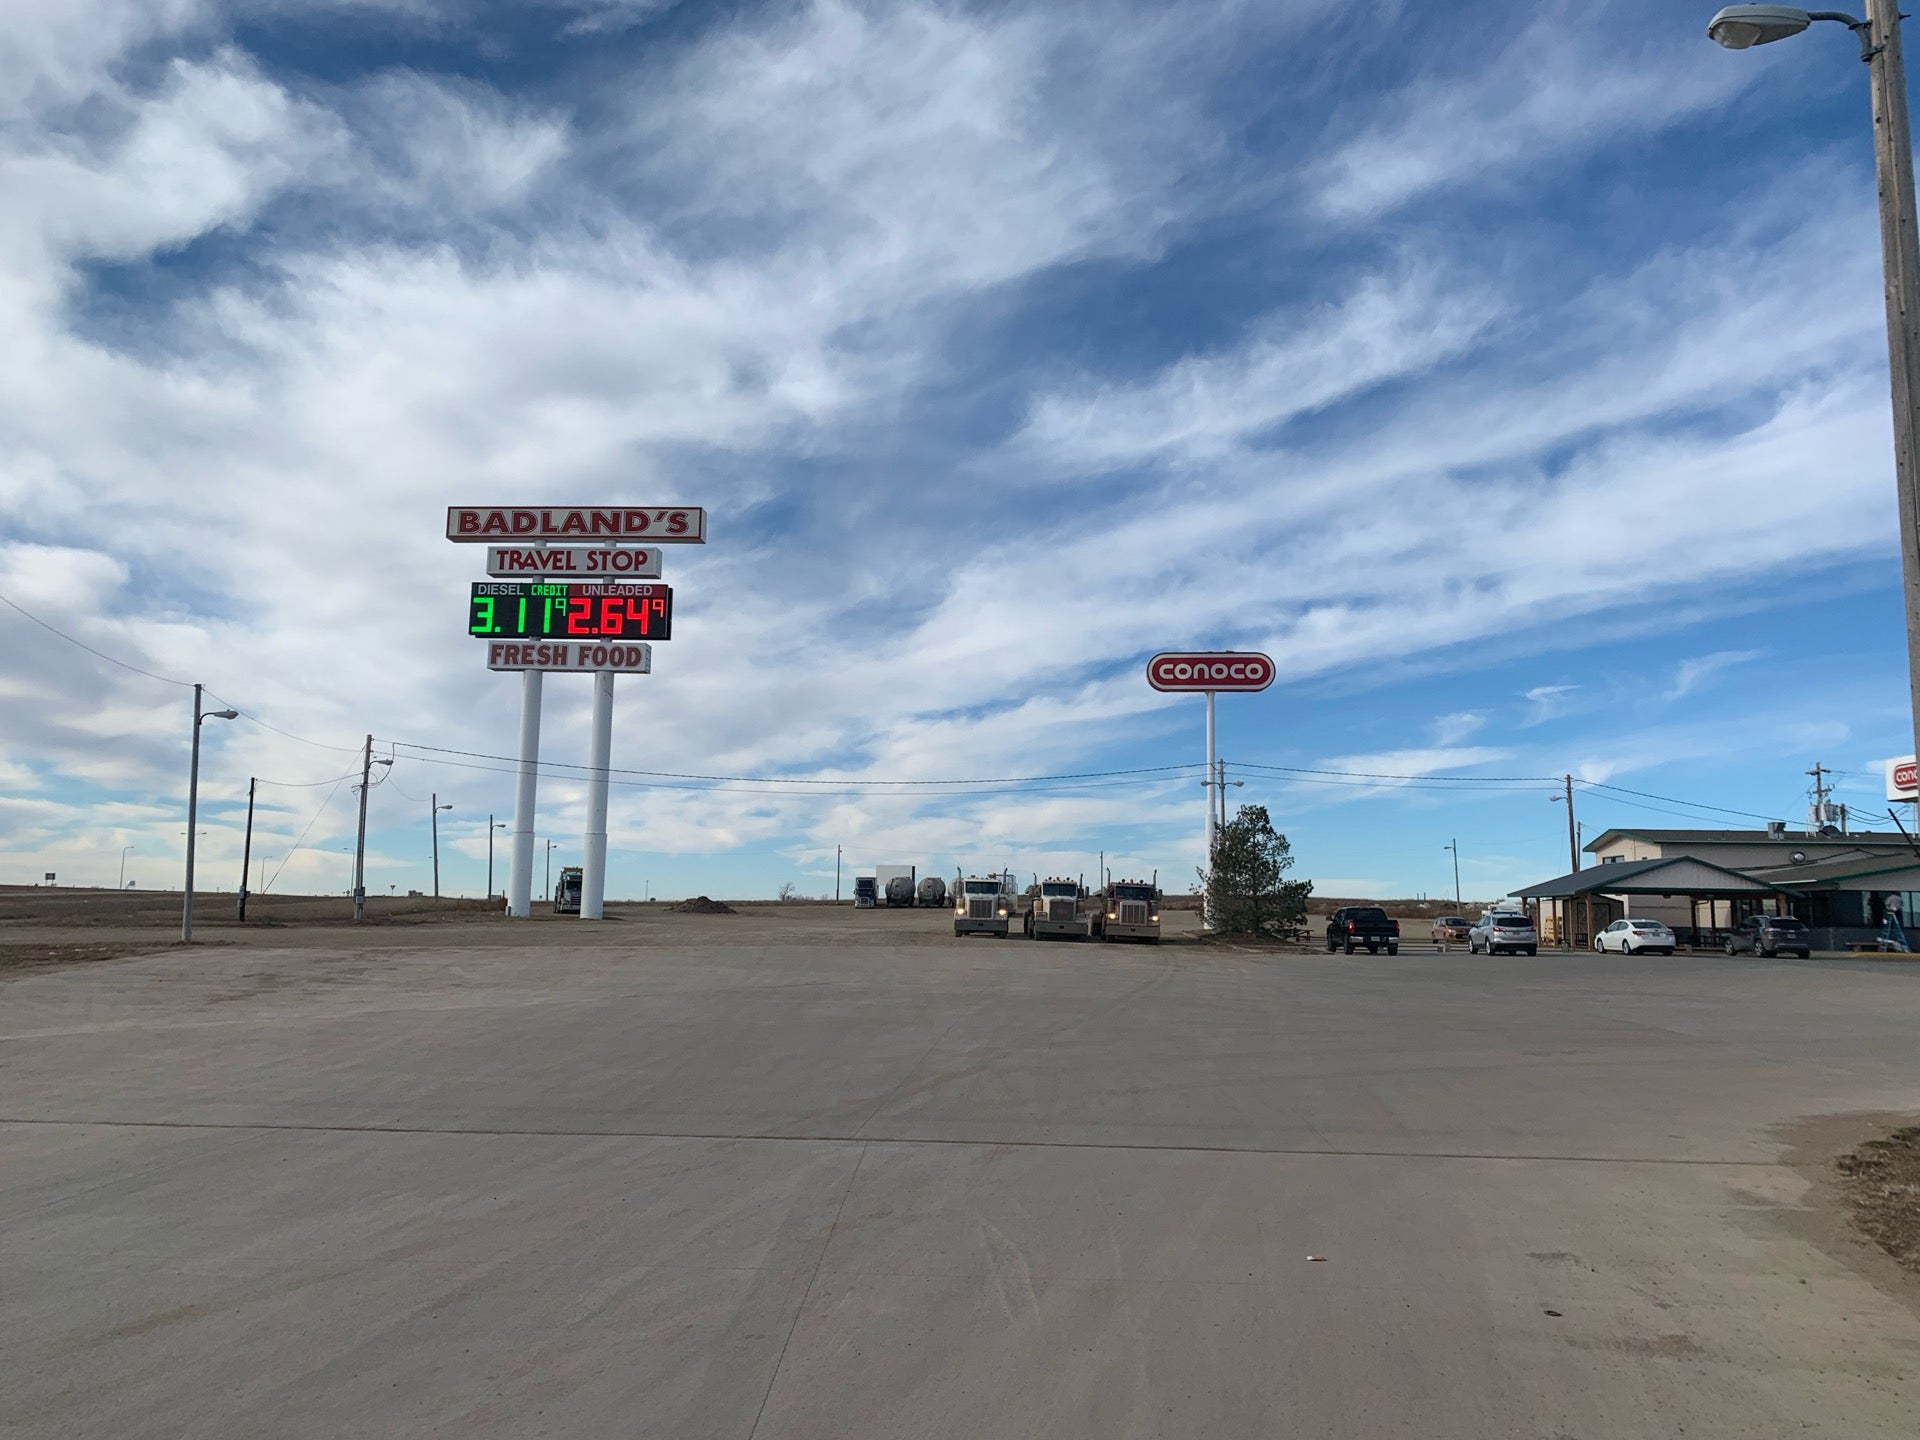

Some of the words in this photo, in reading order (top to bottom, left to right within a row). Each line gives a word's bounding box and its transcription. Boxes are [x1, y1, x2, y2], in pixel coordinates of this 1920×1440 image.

[457, 510, 689, 534] BADLAND'S
[496, 550, 577, 571] TRAVEL
[586, 550, 648, 571] STOP
[478, 584, 524, 595] DIESEL
[531, 584, 568, 596] CREDIT
[582, 584, 653, 596] UNLEADED
[490, 644, 568, 666] FRESH
[578, 646, 642, 667] FOOD
[1158, 663, 1264, 680] conoco
